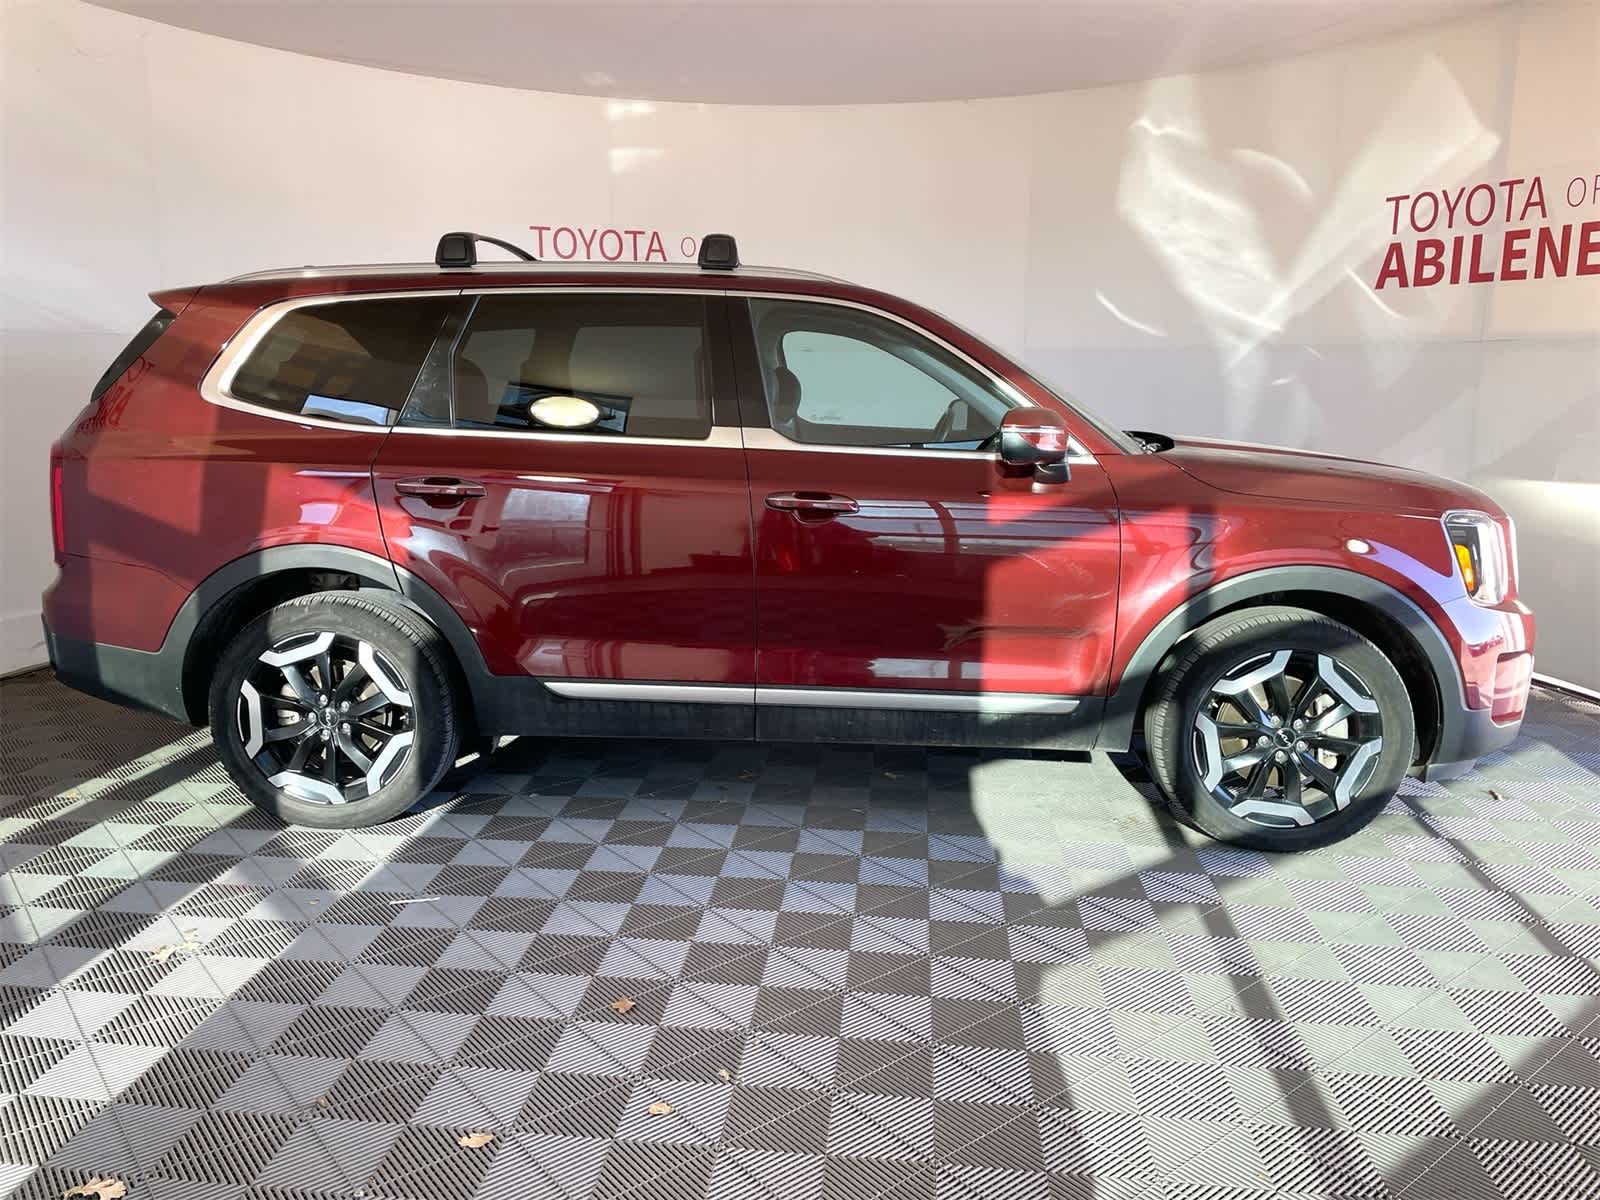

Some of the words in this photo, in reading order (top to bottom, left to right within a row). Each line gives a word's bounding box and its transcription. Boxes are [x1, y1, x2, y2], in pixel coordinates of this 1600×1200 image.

[1385, 176, 1548, 235] TOYOTA
[529, 226, 667, 261] TOYOTA
[1374, 220, 1600, 290] ABILENE
